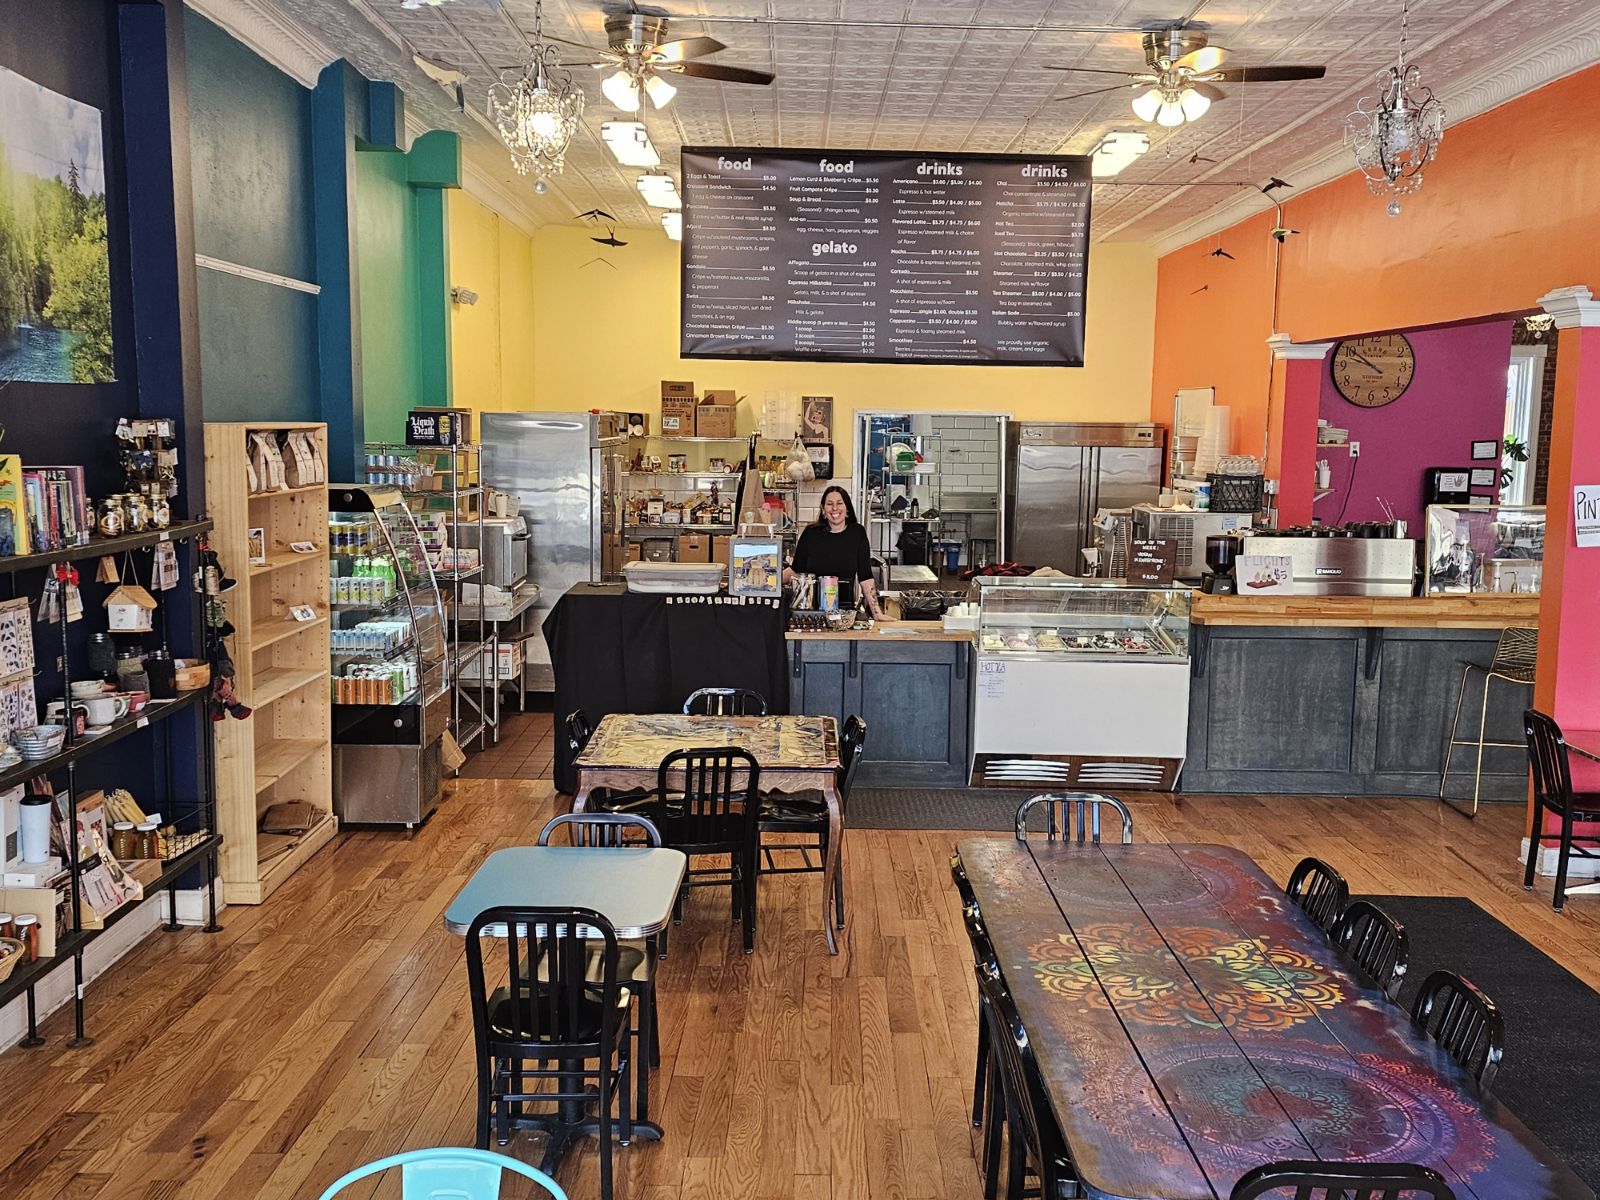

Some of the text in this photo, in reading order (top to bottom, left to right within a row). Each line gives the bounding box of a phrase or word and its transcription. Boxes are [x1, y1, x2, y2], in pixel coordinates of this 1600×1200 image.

[718, 157, 752, 170] food
[819, 159, 854, 173] food
[916, 162, 964, 175] drinks
[1021, 164, 1069, 178] drinks
[812, 241, 858, 256] gelato
[1345, 346, 1357, 358] 10
[1398, 346, 1404, 357] 2
[1340, 360, 1347, 371] 9
[1399, 361, 1407, 372] 3
[1343, 375, 1350, 386] 8
[1394, 375, 1401, 387] 4
[1354, 385, 1360, 397] 7
[1367, 389, 1374, 401] 6
[1383, 386, 1390, 398] 5
[410, 416, 435, 428] Liquid
[413, 425, 435, 435] Death
[1576, 491, 1600, 520] PIN
[1244, 556, 1291, 566] FLIGHTS
